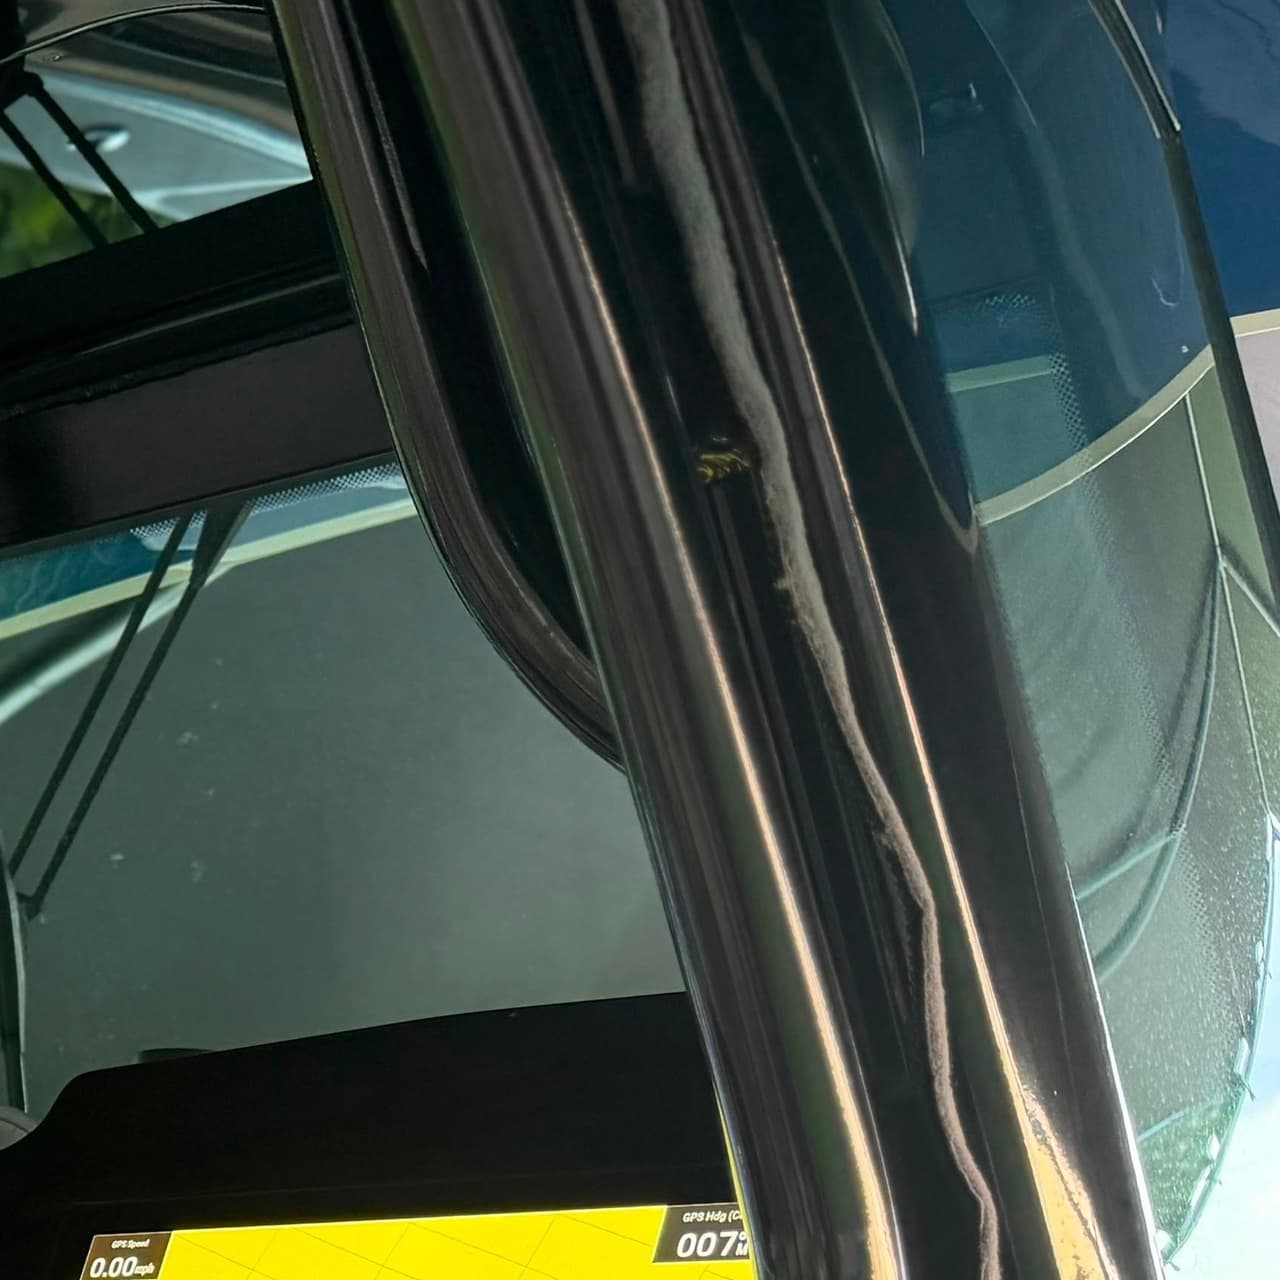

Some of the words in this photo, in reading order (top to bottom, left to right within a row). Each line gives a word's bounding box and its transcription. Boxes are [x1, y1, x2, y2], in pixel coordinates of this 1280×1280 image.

[682, 1212, 705, 1223] GPS
[705, 1210, 728, 1224] Hdg
[111, 1240, 127, 1249] GPS
[127, 1238, 151, 1249] Speed
